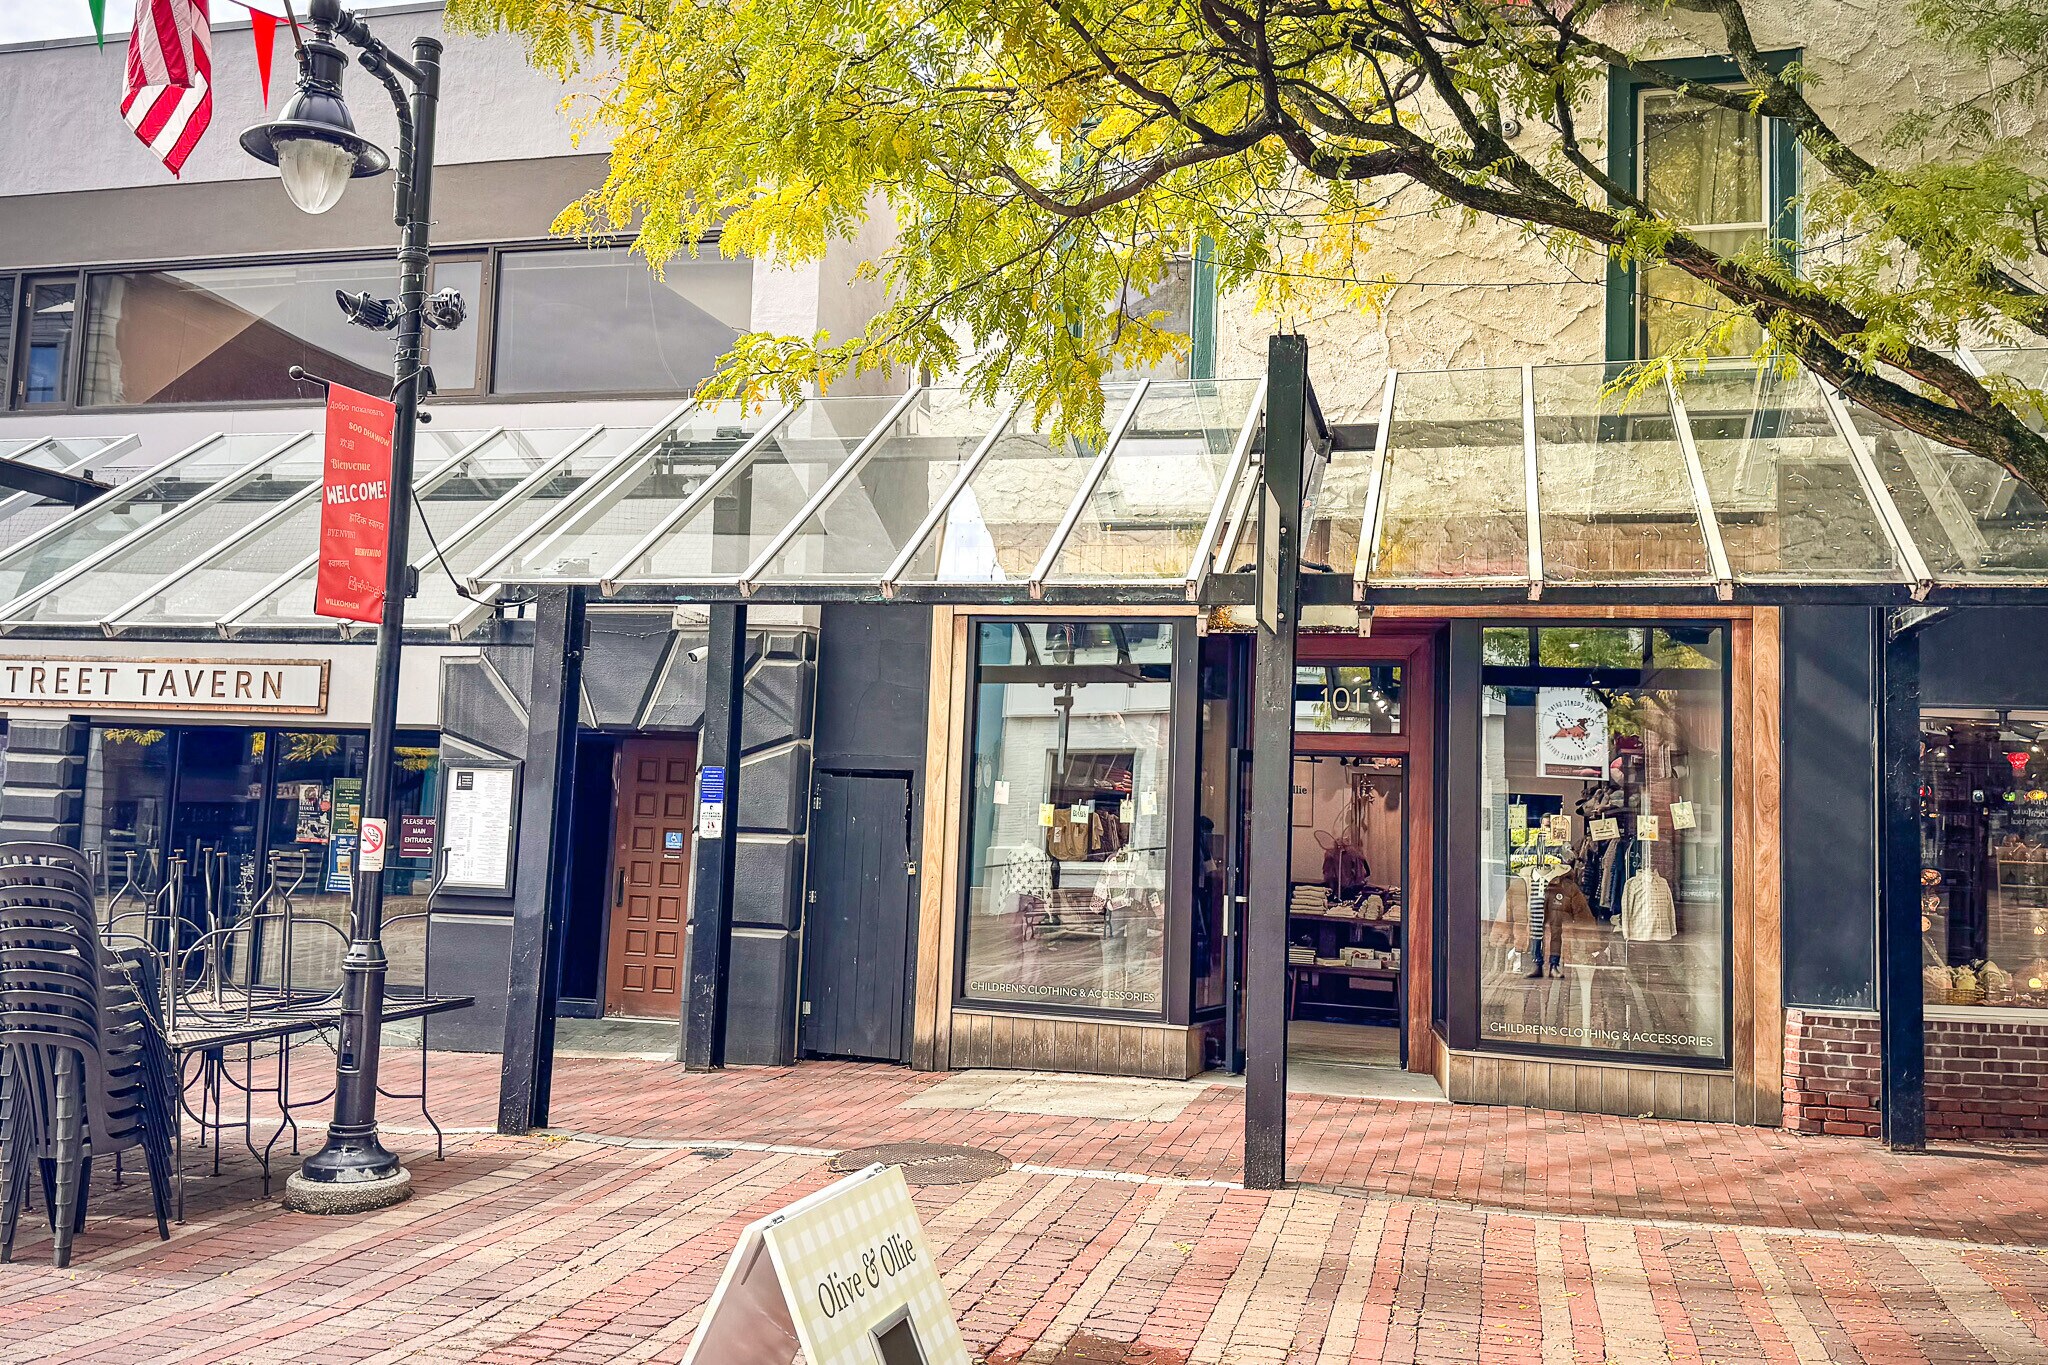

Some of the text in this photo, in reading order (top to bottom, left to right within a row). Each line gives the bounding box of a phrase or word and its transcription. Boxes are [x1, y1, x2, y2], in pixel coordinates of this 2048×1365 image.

[330, 400, 385, 417] Добро пожаловать
[348, 422, 390, 447] SOO DHAWOW
[330, 458, 371, 471] Bienvenue
[326, 480, 387, 505] WELCOME!
[327, 528, 356, 539] BYENVINI
[324, 597, 359, 609] WILLKOMMEN
[6, 666, 283, 700] TREET TAVERN
[1320, 687, 1361, 712] 101
[970, 981, 1155, 1003] CHILDREN'S CLOTHING & ACCESSORIES
[1490, 1021, 1713, 1047] CHILDREN'S CLOTHING & ACCESSORIES
[818, 1233, 917, 1319] Olive & Ollie
